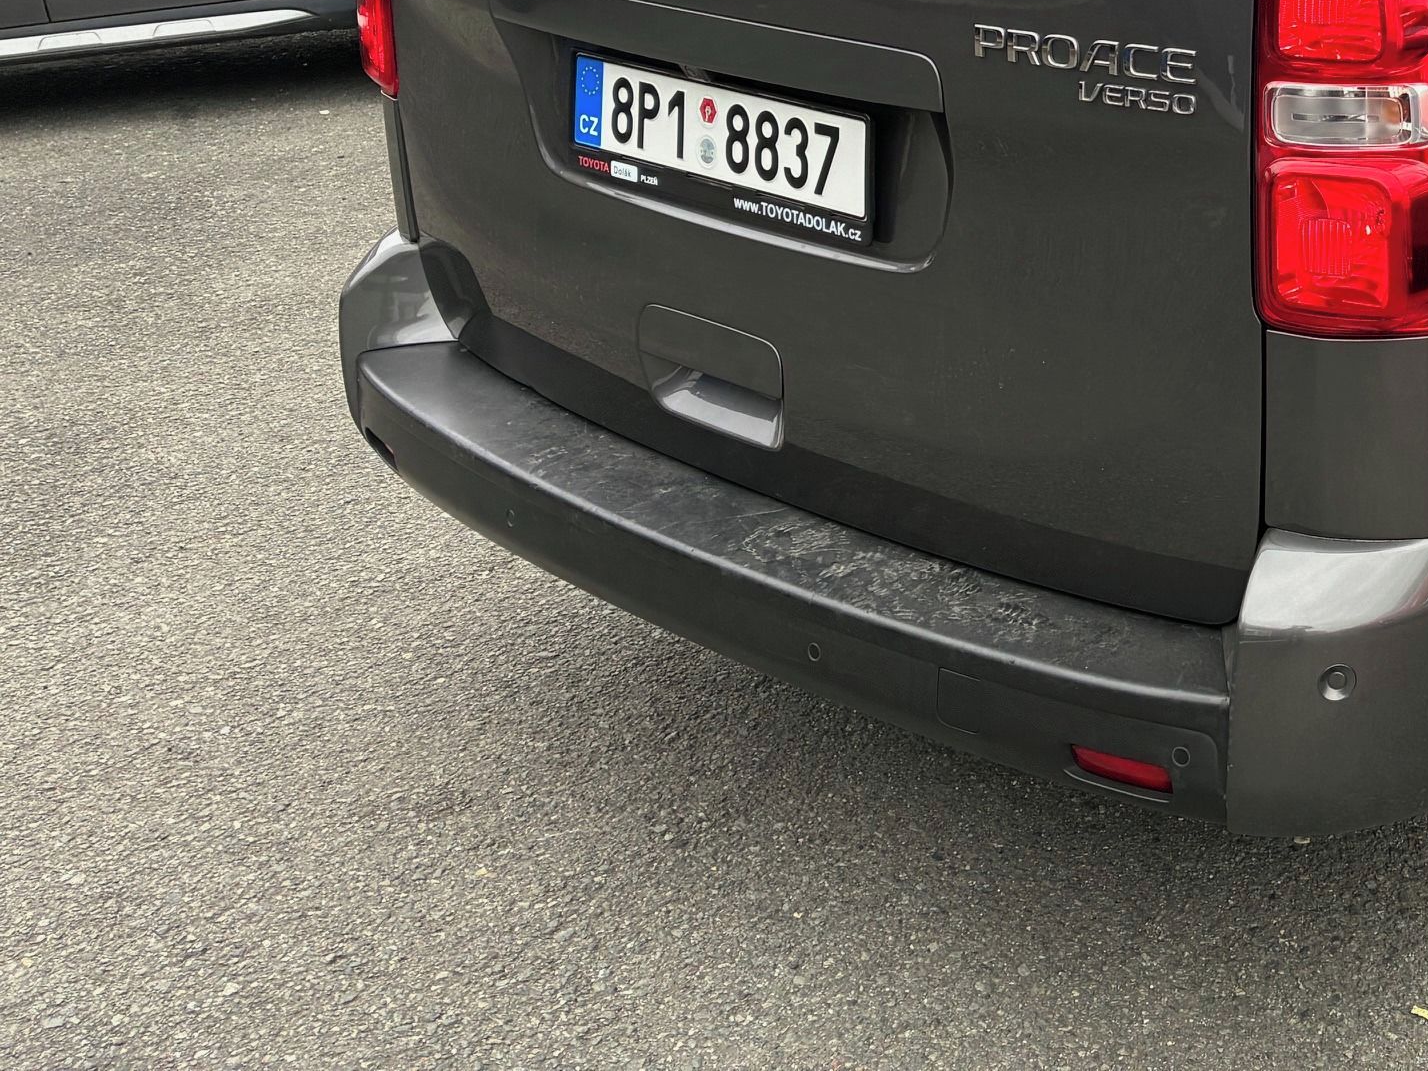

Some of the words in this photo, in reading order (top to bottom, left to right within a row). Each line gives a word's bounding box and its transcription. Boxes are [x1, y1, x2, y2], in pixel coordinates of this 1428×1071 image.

[974, 23, 1197, 84] PROACE
[1078, 80, 1197, 115] VERSO
[579, 114, 599, 137] CZ
[611, 76, 686, 160] 8P1
[725, 103, 840, 196] 8837
[578, 156, 610, 173] TOYOTA
[733, 197, 862, 241] www.TOYOTADOLAK.cz
